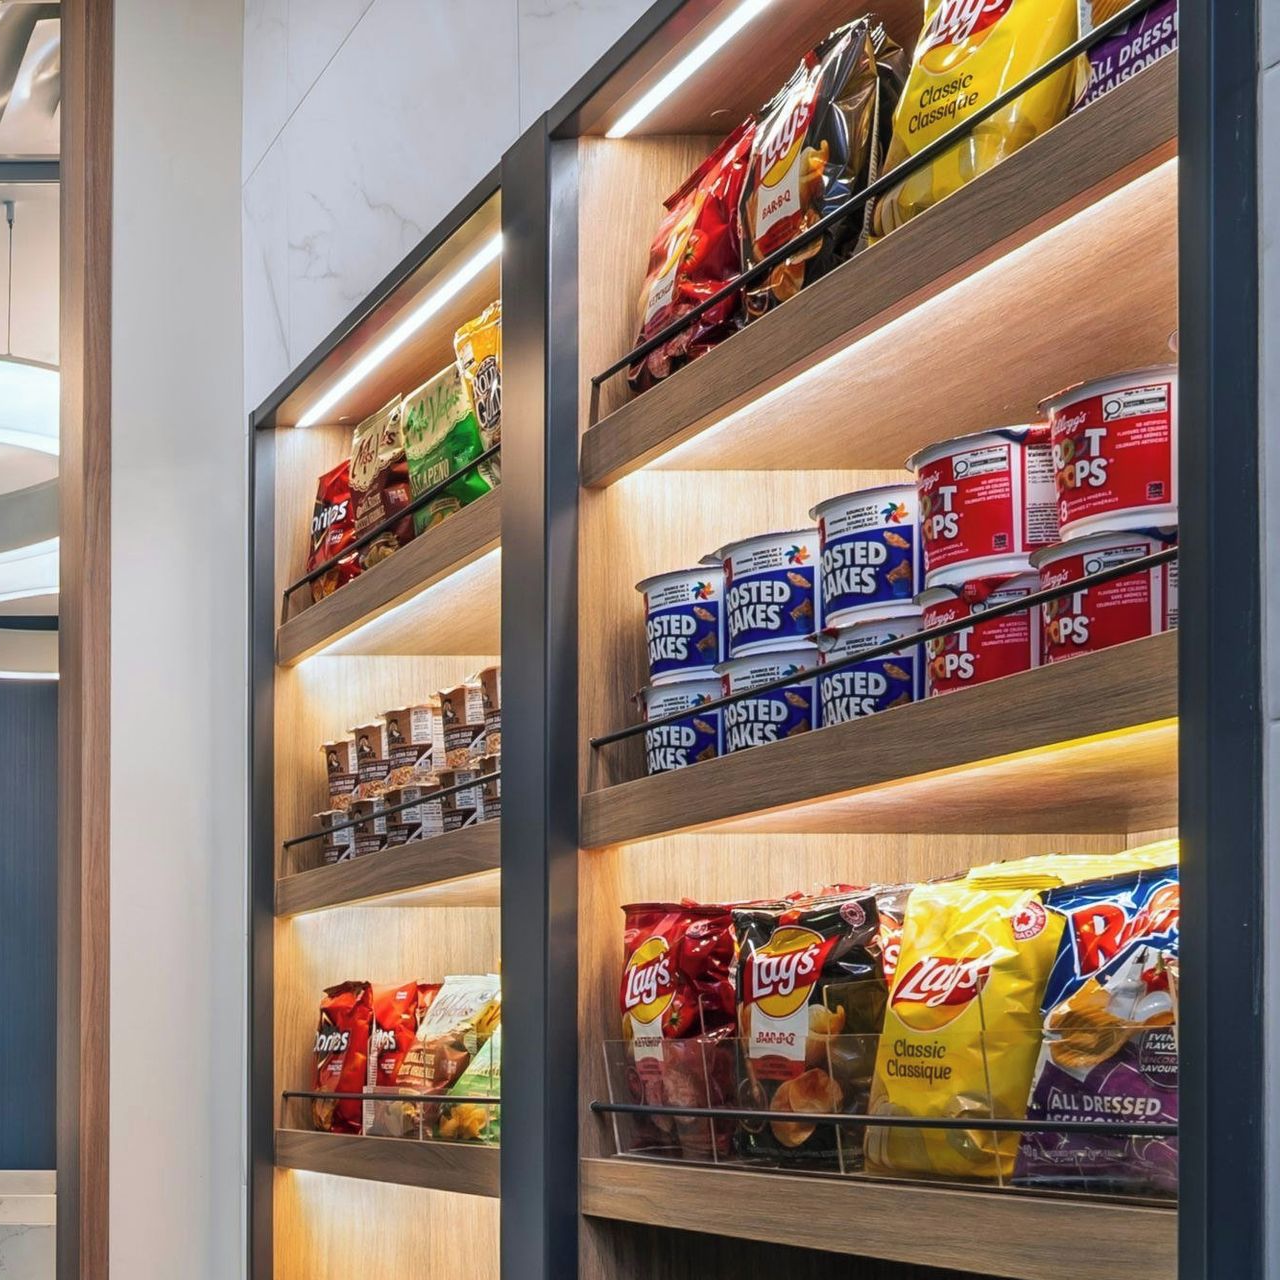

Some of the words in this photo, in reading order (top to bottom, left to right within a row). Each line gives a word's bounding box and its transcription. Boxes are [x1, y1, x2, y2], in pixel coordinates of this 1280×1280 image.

[1090, 60, 1115, 85] ALL
[919, 72, 974, 109] Classic
[907, 91, 980, 135] Classique
[625, 952, 672, 1009] Lay's
[752, 944, 821, 999] Lay's
[893, 1039, 947, 1060] Classic
[886, 1059, 953, 1085] Classique
[1050, 1093, 1079, 1111] ALL
[1083, 1097, 1161, 1116] DRESSED
